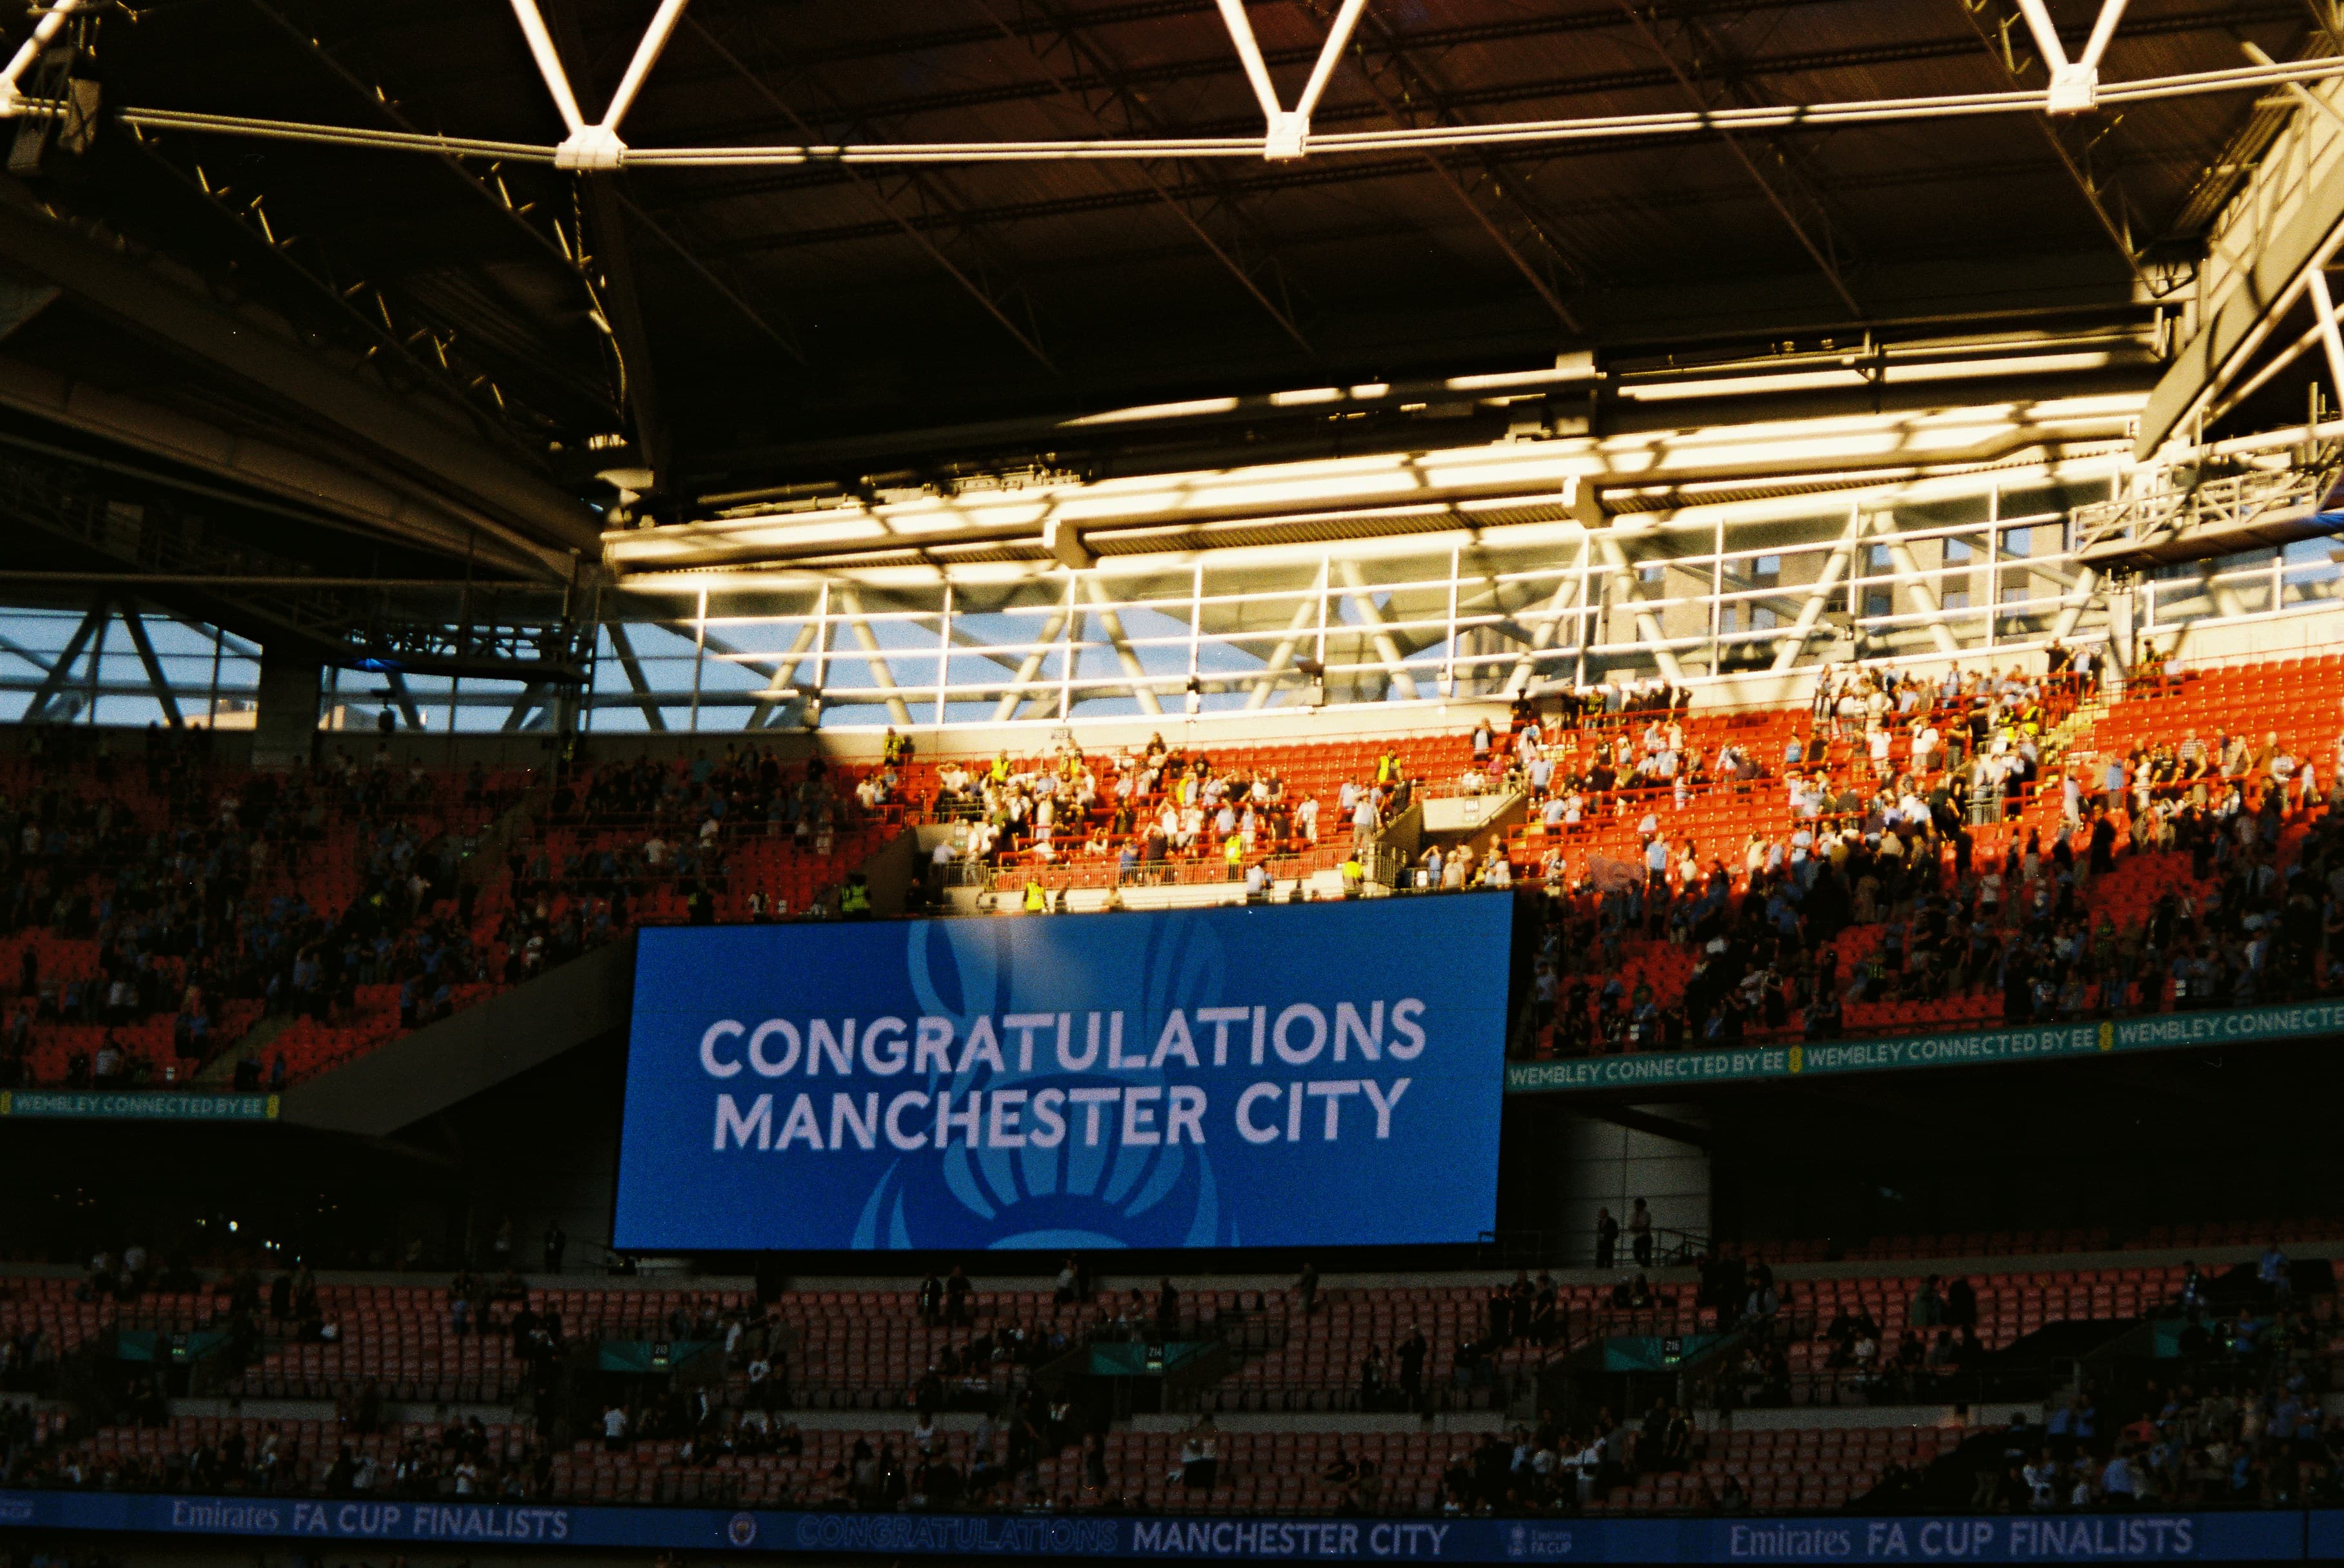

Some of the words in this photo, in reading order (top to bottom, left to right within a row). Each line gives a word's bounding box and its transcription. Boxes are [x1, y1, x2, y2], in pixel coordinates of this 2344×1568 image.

[699, 998, 1426, 1078] CONGRATULATIONS
[1806, 1041, 1904, 1067] WEMBLEY
[1907, 1032, 2038, 1060] CONNECTED
[2040, 1031, 2068, 1051] BY
[2071, 1028, 2094, 1048] EE
[2118, 1016, 2221, 1042] WEMBLEY
[1509, 1061, 1604, 1087] WEMBLEY
[1605, 1054, 1730, 1081] CONNECTED
[1732, 1052, 1761, 1072] BY
[1761, 1050, 1784, 1070] EE
[15, 1095, 101, 1113] WEMBLEY
[102, 1096, 215, 1114] CONNECTED
[216, 1097, 241, 1115] BY
[242, 1097, 262, 1114] EE
[713, 1085, 1206, 1151] MANCHESTER
[1235, 1078, 1411, 1144] CITY
[172, 1499, 280, 1531] Emirates
[293, 1503, 329, 1534] FA
[338, 1504, 402, 1534] CUP
[412, 1505, 568, 1539] FINALISTS
[795, 1514, 1119, 1551] CONGRATULATIONS
[1132, 1520, 1359, 1554] MANCHESTER
[1370, 1523, 1451, 1555] CITY
[1730, 1523, 1852, 1557] Emirates
[1868, 1521, 1910, 1556] FA
[1918, 1520, 1995, 1556] CUP
[2009, 1518, 2193, 1557] FINALISTS
[1547, 1541, 1572, 1554] CUP
